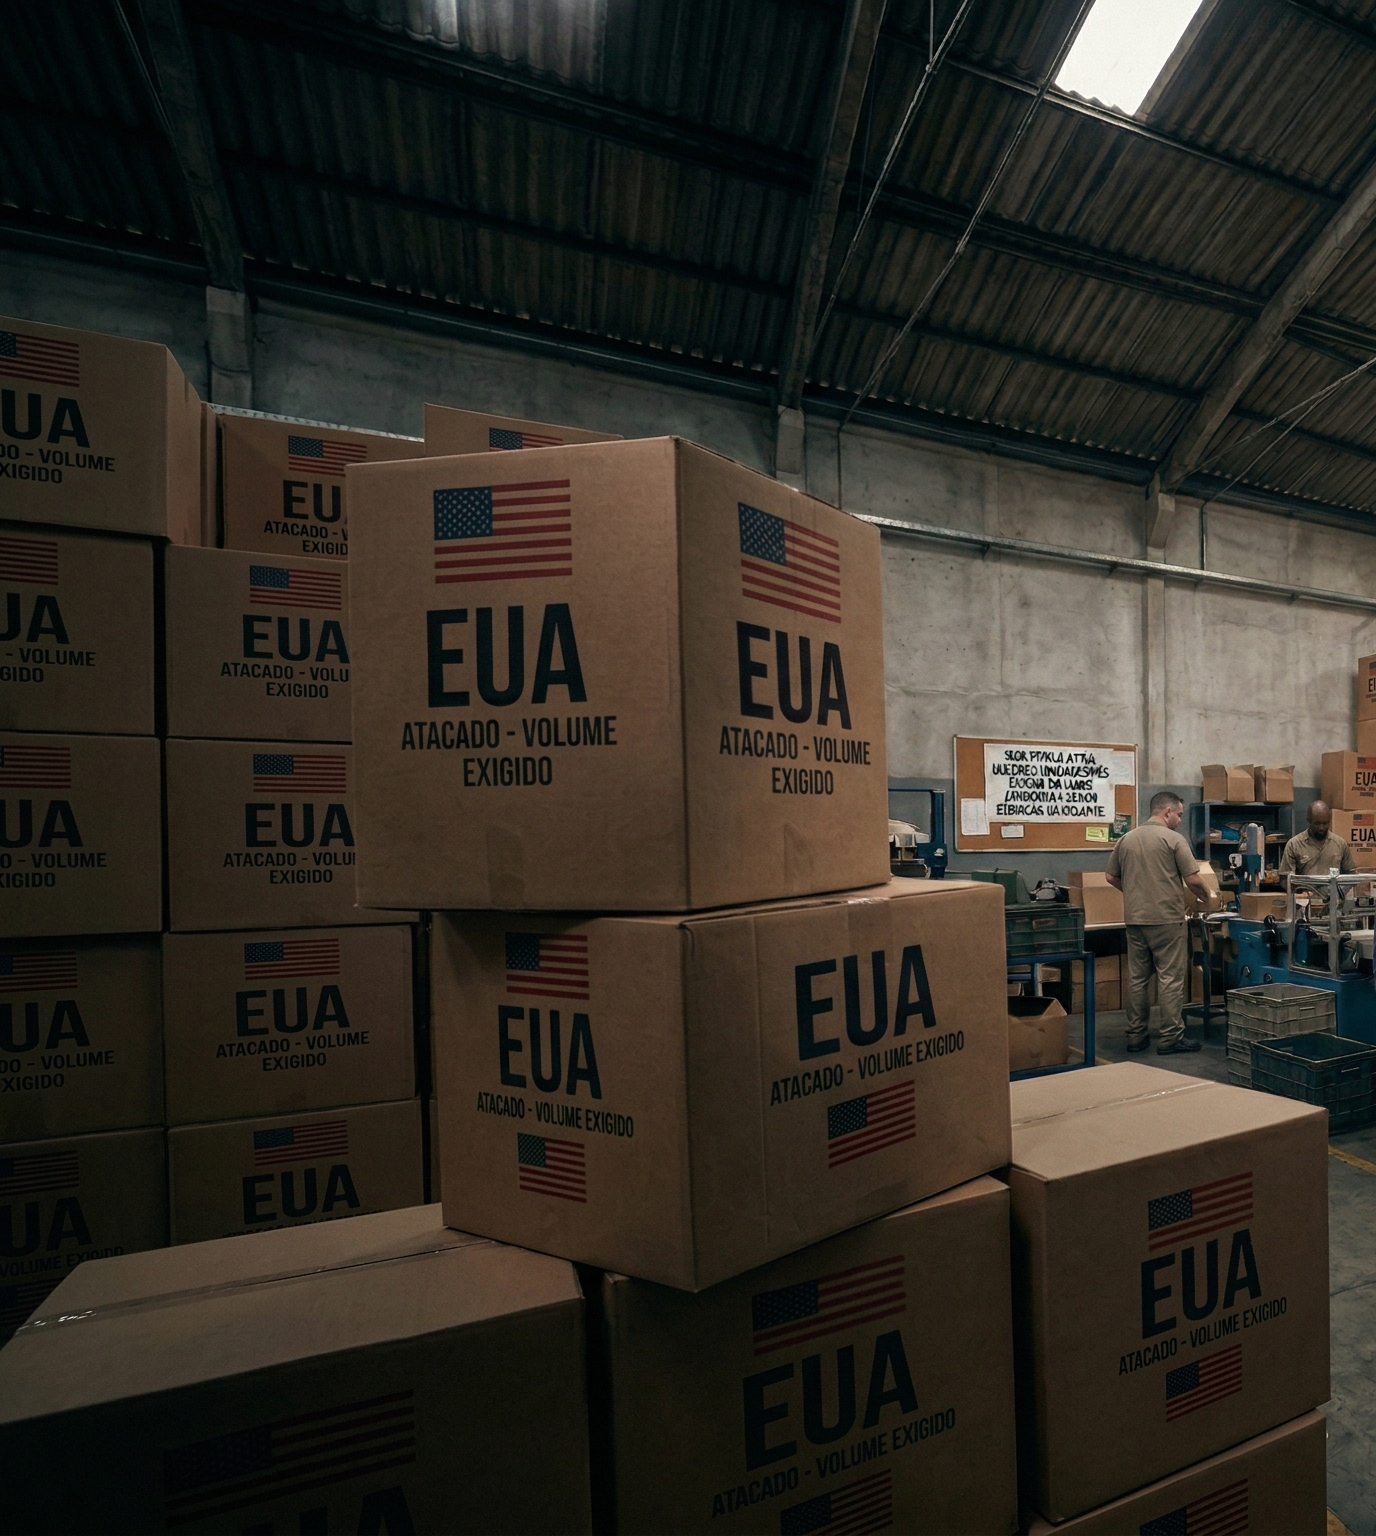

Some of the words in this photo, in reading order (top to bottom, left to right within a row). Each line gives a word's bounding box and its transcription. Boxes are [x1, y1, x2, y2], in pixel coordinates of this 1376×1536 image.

[2, 389, 90, 448] UA
[0, 463, 63, 484] XIGIDO
[39, 448, 115, 472] VOLUME
[283, 480, 348, 524] EU
[264, 520, 328, 539] ATACADO
[302, 539, 348, 556] EXIGID
[19, 648, 96, 667] VOLUME
[243, 614, 350, 664] EUA
[426, 603, 588, 708] EUA
[221, 662, 294, 680] ATACADO
[310, 667, 349, 682] VOLU
[266, 682, 329, 699] EXIGIDO
[736, 621, 852, 730] EUA
[401, 720, 500, 751] ATACADO
[522, 716, 618, 748] VOLUME
[719, 726, 798, 760] ATACADO
[813, 736, 872, 766] VOLUME
[463, 756, 553, 788] EXIGIDO
[771, 767, 834, 796] EXIGIDO
[0, 800, 84, 849] UA
[245, 803, 355, 848] EUA
[1351, 828, 1376, 842] EUA
[32, 853, 107, 868] VOLUME
[223, 852, 297, 867] ATACADO
[312, 852, 355, 866] VOLU
[269, 869, 333, 884] EXIGIDO
[236, 985, 350, 1037] EUA
[794, 944, 937, 1061] EUA
[0, 1000, 91, 1053] UA
[216, 1039, 291, 1058] ATACADO
[306, 1031, 370, 1049] VOLUME
[41, 1051, 115, 1071] VOLUME
[262, 1052, 327, 1072] EXIGIDO
[498, 1004, 602, 1100] EUA
[770, 1063, 843, 1107] ATACADO
[858, 1044, 912, 1081] VOLUME
[915, 1030, 965, 1064] EXIGIDO
[1, 1073, 65, 1093] XIGIDO
[477, 1091, 525, 1119] ATACADO
[535, 1101, 583, 1131] VOLUME
[585, 1111, 634, 1138] EXIGIDO
[242, 1164, 361, 1225] EUA
[0, 1196, 93, 1257] UA
[1140, 1229, 1262, 1340] EUA
[1119, 1339, 1177, 1375] ATACADO
[1189, 1317, 1240, 1349] VOLUME
[1243, 1296, 1288, 1331] EXIGIDO
[742, 1330, 918, 1472] EUA
[711, 1465, 799, 1518] ATACADO
[815, 1436, 888, 1480] VOLUME
[891, 1408, 957, 1450] EXIGIDO
